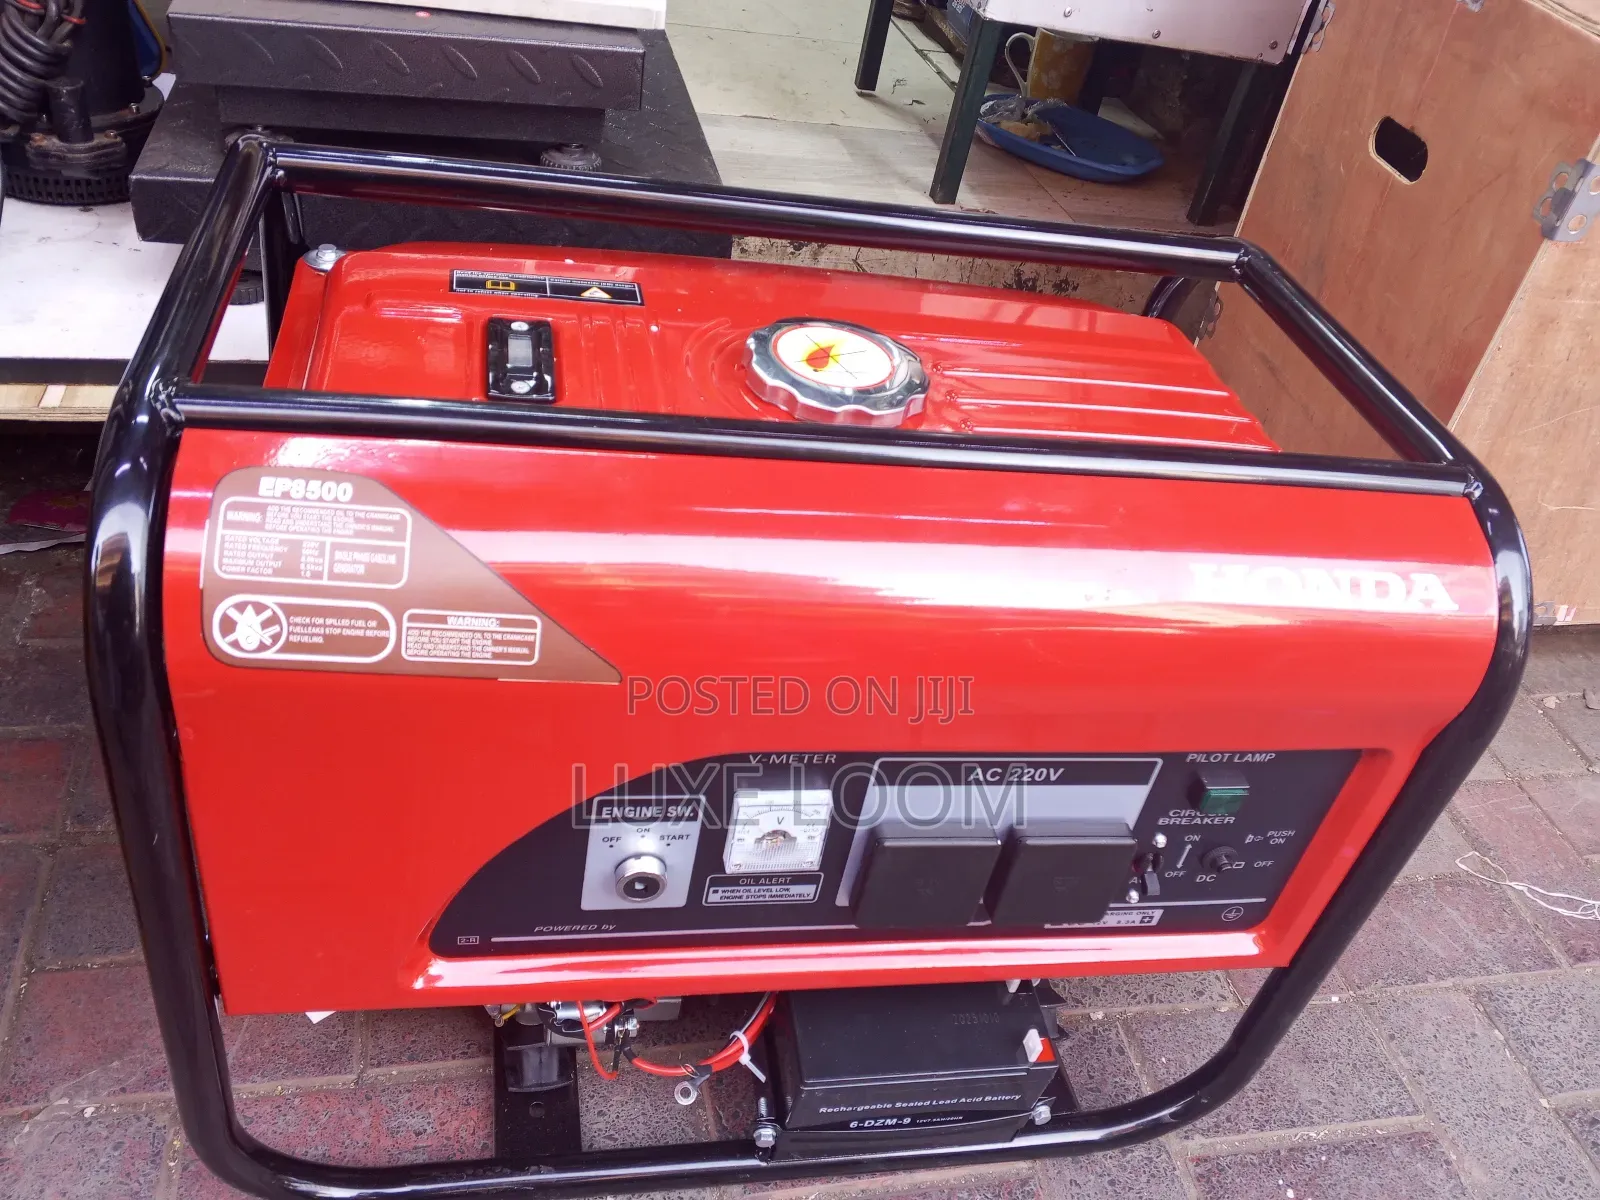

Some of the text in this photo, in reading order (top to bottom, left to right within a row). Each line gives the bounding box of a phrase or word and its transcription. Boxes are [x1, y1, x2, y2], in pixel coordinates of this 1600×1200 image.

[258, 476, 353, 503] EP8500
[247, 551, 274, 559] OUTPUT
[255, 559, 283, 568] OUTPUT
[247, 566, 273, 574] FACTOR
[1187, 563, 1460, 613] HONDA
[290, 616, 378, 628] CHECK FOR SPILLED FUEL OR
[447, 616, 500, 628] WARNING:
[325, 627, 342, 635] STOP
[342, 628, 365, 637] ENGINE
[366, 629, 389, 638] BEFORE
[407, 629, 420, 637] ADD
[432, 631, 473, 640] RECOMMENDED
[442, 637, 460, 645] START
[407, 649, 428, 657] BEFORE
[428, 650, 460, 658] OPERATING
[749, 753, 837, 765] V-METER
[1186, 752, 1277, 763] PILOT LAMP
[967, 766, 1065, 783] AC 220V
[602, 804, 695, 819] ENGINE SW.
[777, 816, 786, 825] V
[1158, 816, 1236, 826] BREAKER
[1185, 834, 1202, 843] ON
[1267, 830, 1297, 838] PUSH
[1254, 860, 1276, 868] OFF
[1165, 871, 1188, 879] OFF
[1195, 874, 1218, 883] DC
[739, 876, 792, 886] OIL ALERT
[534, 924, 617, 933] POWERED by
[818, 1093, 1022, 1115] Rechargeable Sealed Lead Acid Battery
[849, 1117, 912, 1129] 6-DZM-9
